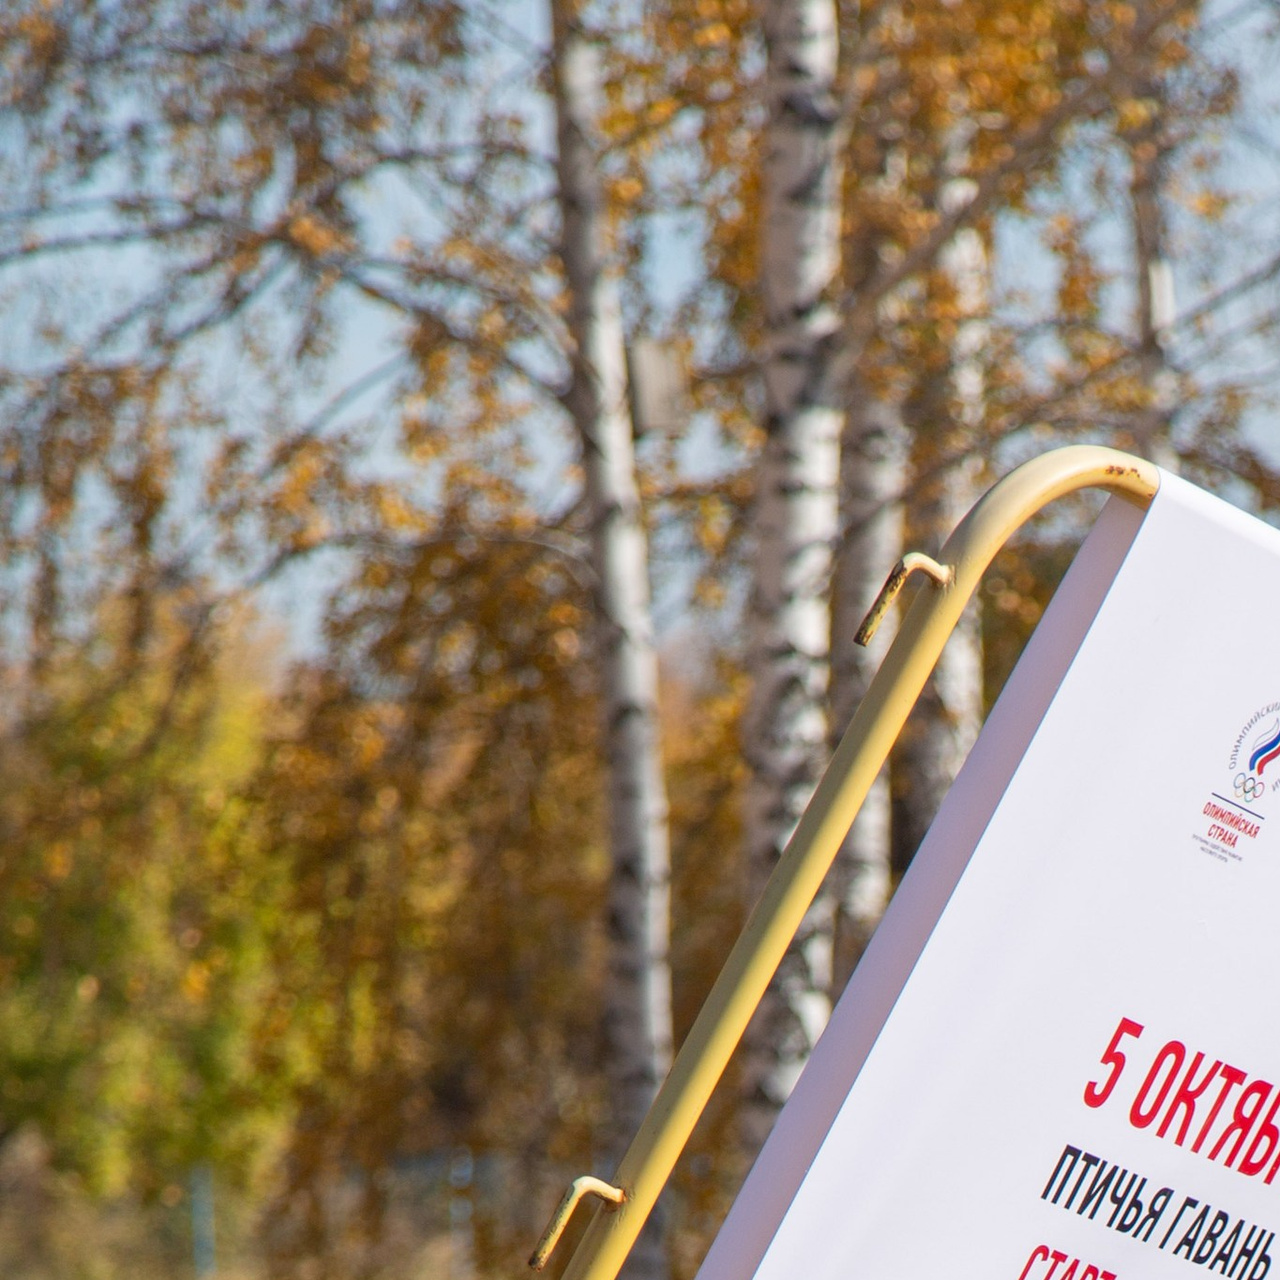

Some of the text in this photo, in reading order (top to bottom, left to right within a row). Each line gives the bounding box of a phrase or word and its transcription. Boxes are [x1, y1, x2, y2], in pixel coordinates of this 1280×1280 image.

[1202, 801, 1261, 839] ОЛИМПИЙСКАЯ
[1207, 823, 1239, 848] СТРАНА
[1083, 1016, 1145, 1108] 5
[1040, 1144, 1174, 1243] ПТИЧЬЯ
